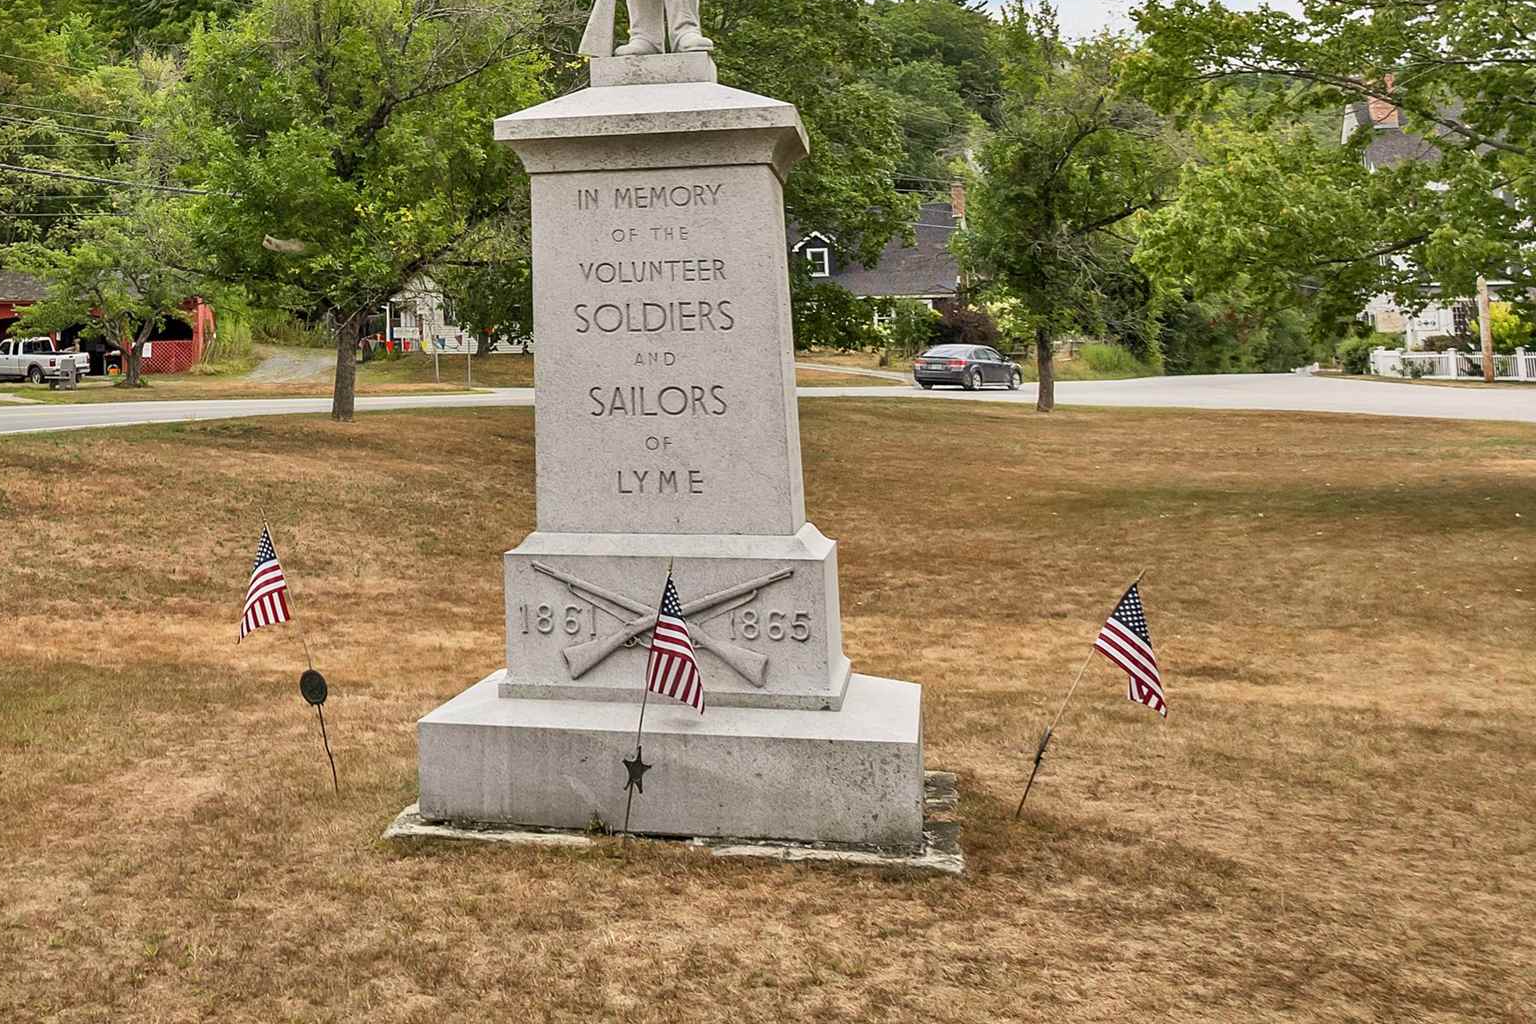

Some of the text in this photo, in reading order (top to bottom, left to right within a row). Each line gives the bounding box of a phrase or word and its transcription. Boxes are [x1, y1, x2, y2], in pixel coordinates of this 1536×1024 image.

[577, 184, 722, 211] IN MEMORY
[611, 226, 689, 243] OF THE
[579, 259, 728, 284] VOLUNTEER
[574, 300, 736, 334] SOLDIERS
[634, 351, 677, 367] AND
[588, 384, 728, 417] SAILORS
[644, 436, 673, 451] OF
[617, 470, 705, 494] LYME
[519, 604, 598, 637] 1861
[728, 609, 813, 643] 1865
